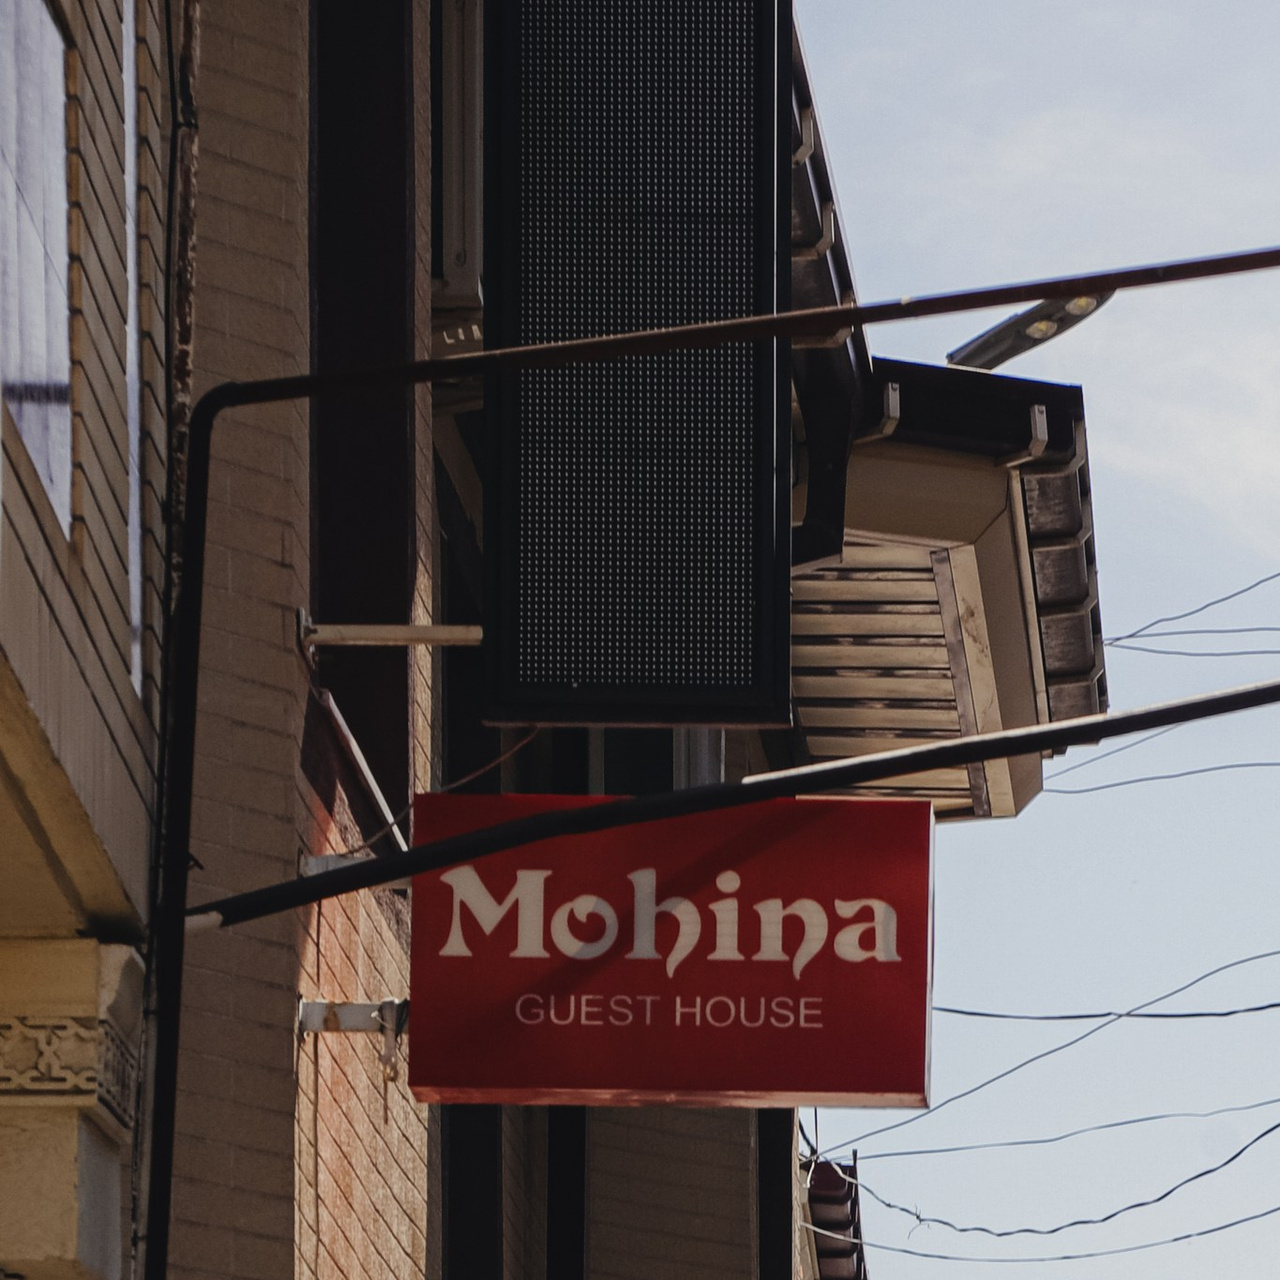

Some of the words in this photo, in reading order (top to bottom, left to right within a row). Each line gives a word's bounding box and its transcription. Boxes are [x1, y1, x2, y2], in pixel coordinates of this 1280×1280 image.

[439, 865, 901, 979] Mohina
[515, 994, 660, 1026] GUEST
[675, 995, 823, 1028] HOUSE
